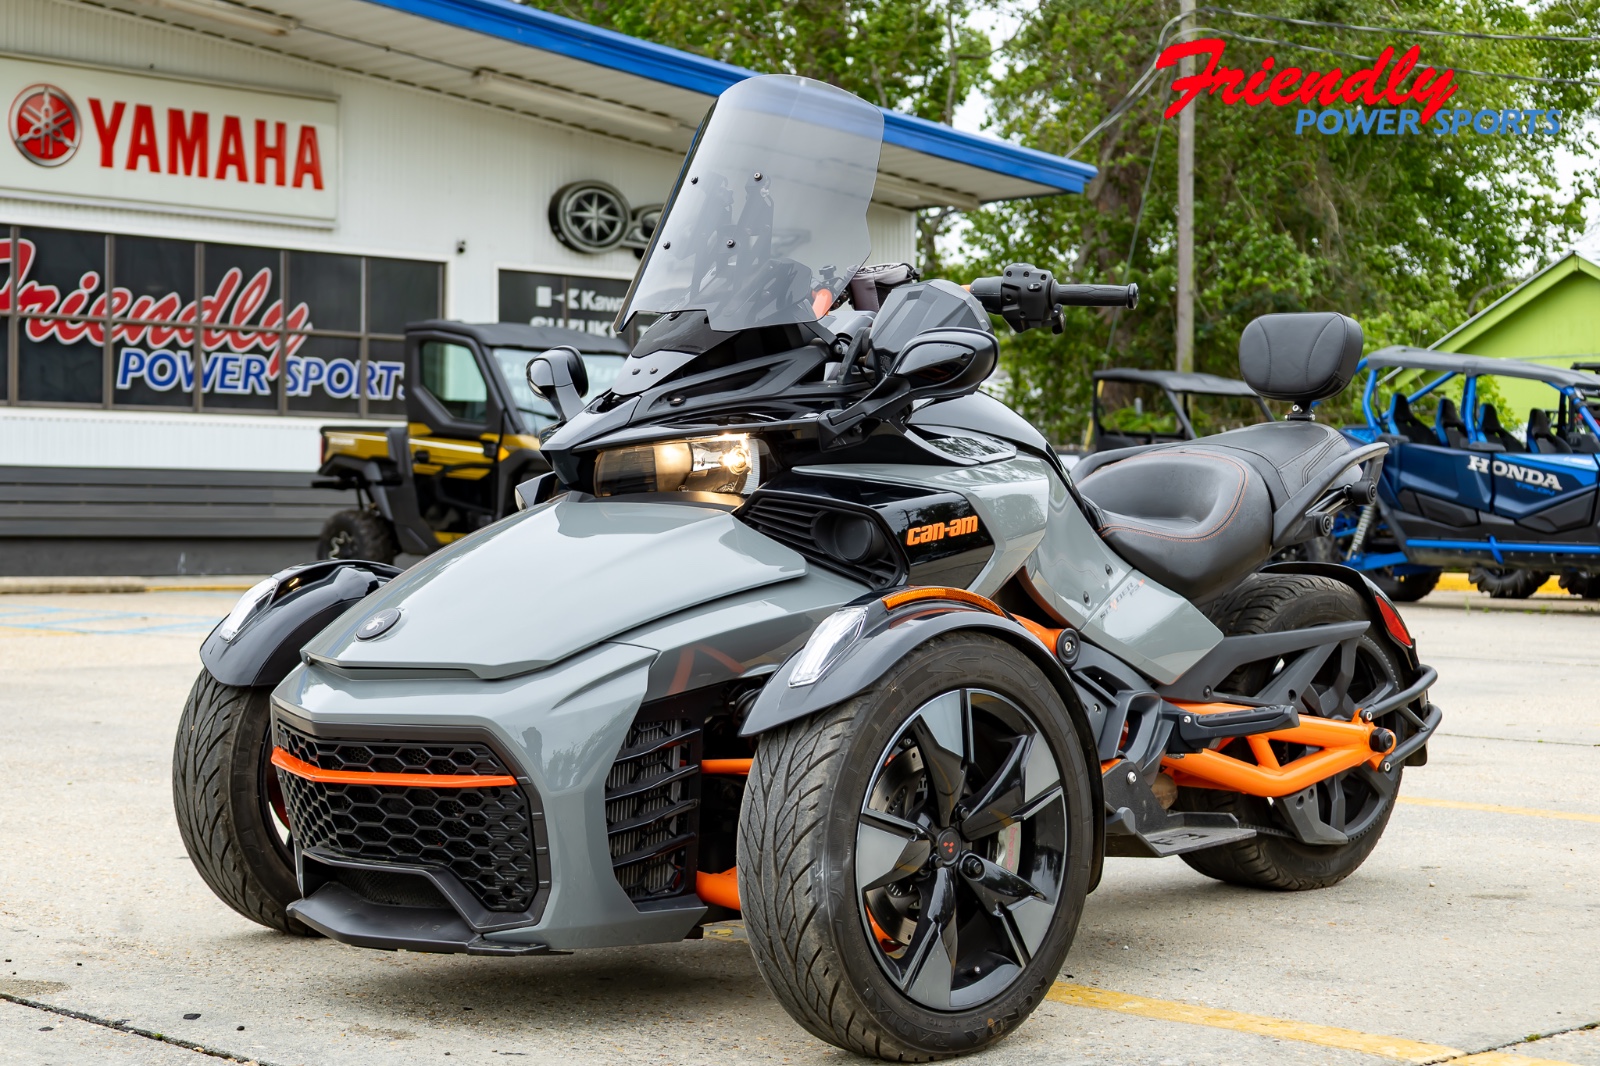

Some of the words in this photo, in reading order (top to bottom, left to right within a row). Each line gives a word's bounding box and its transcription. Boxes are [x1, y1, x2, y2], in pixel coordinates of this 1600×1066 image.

[87, 97, 324, 191] YAMAHA
[117, 347, 271, 395] POWER
[285, 356, 406, 400] SPORT
[1466, 455, 1563, 491] HONDA
[906, 515, 978, 546] can-am
